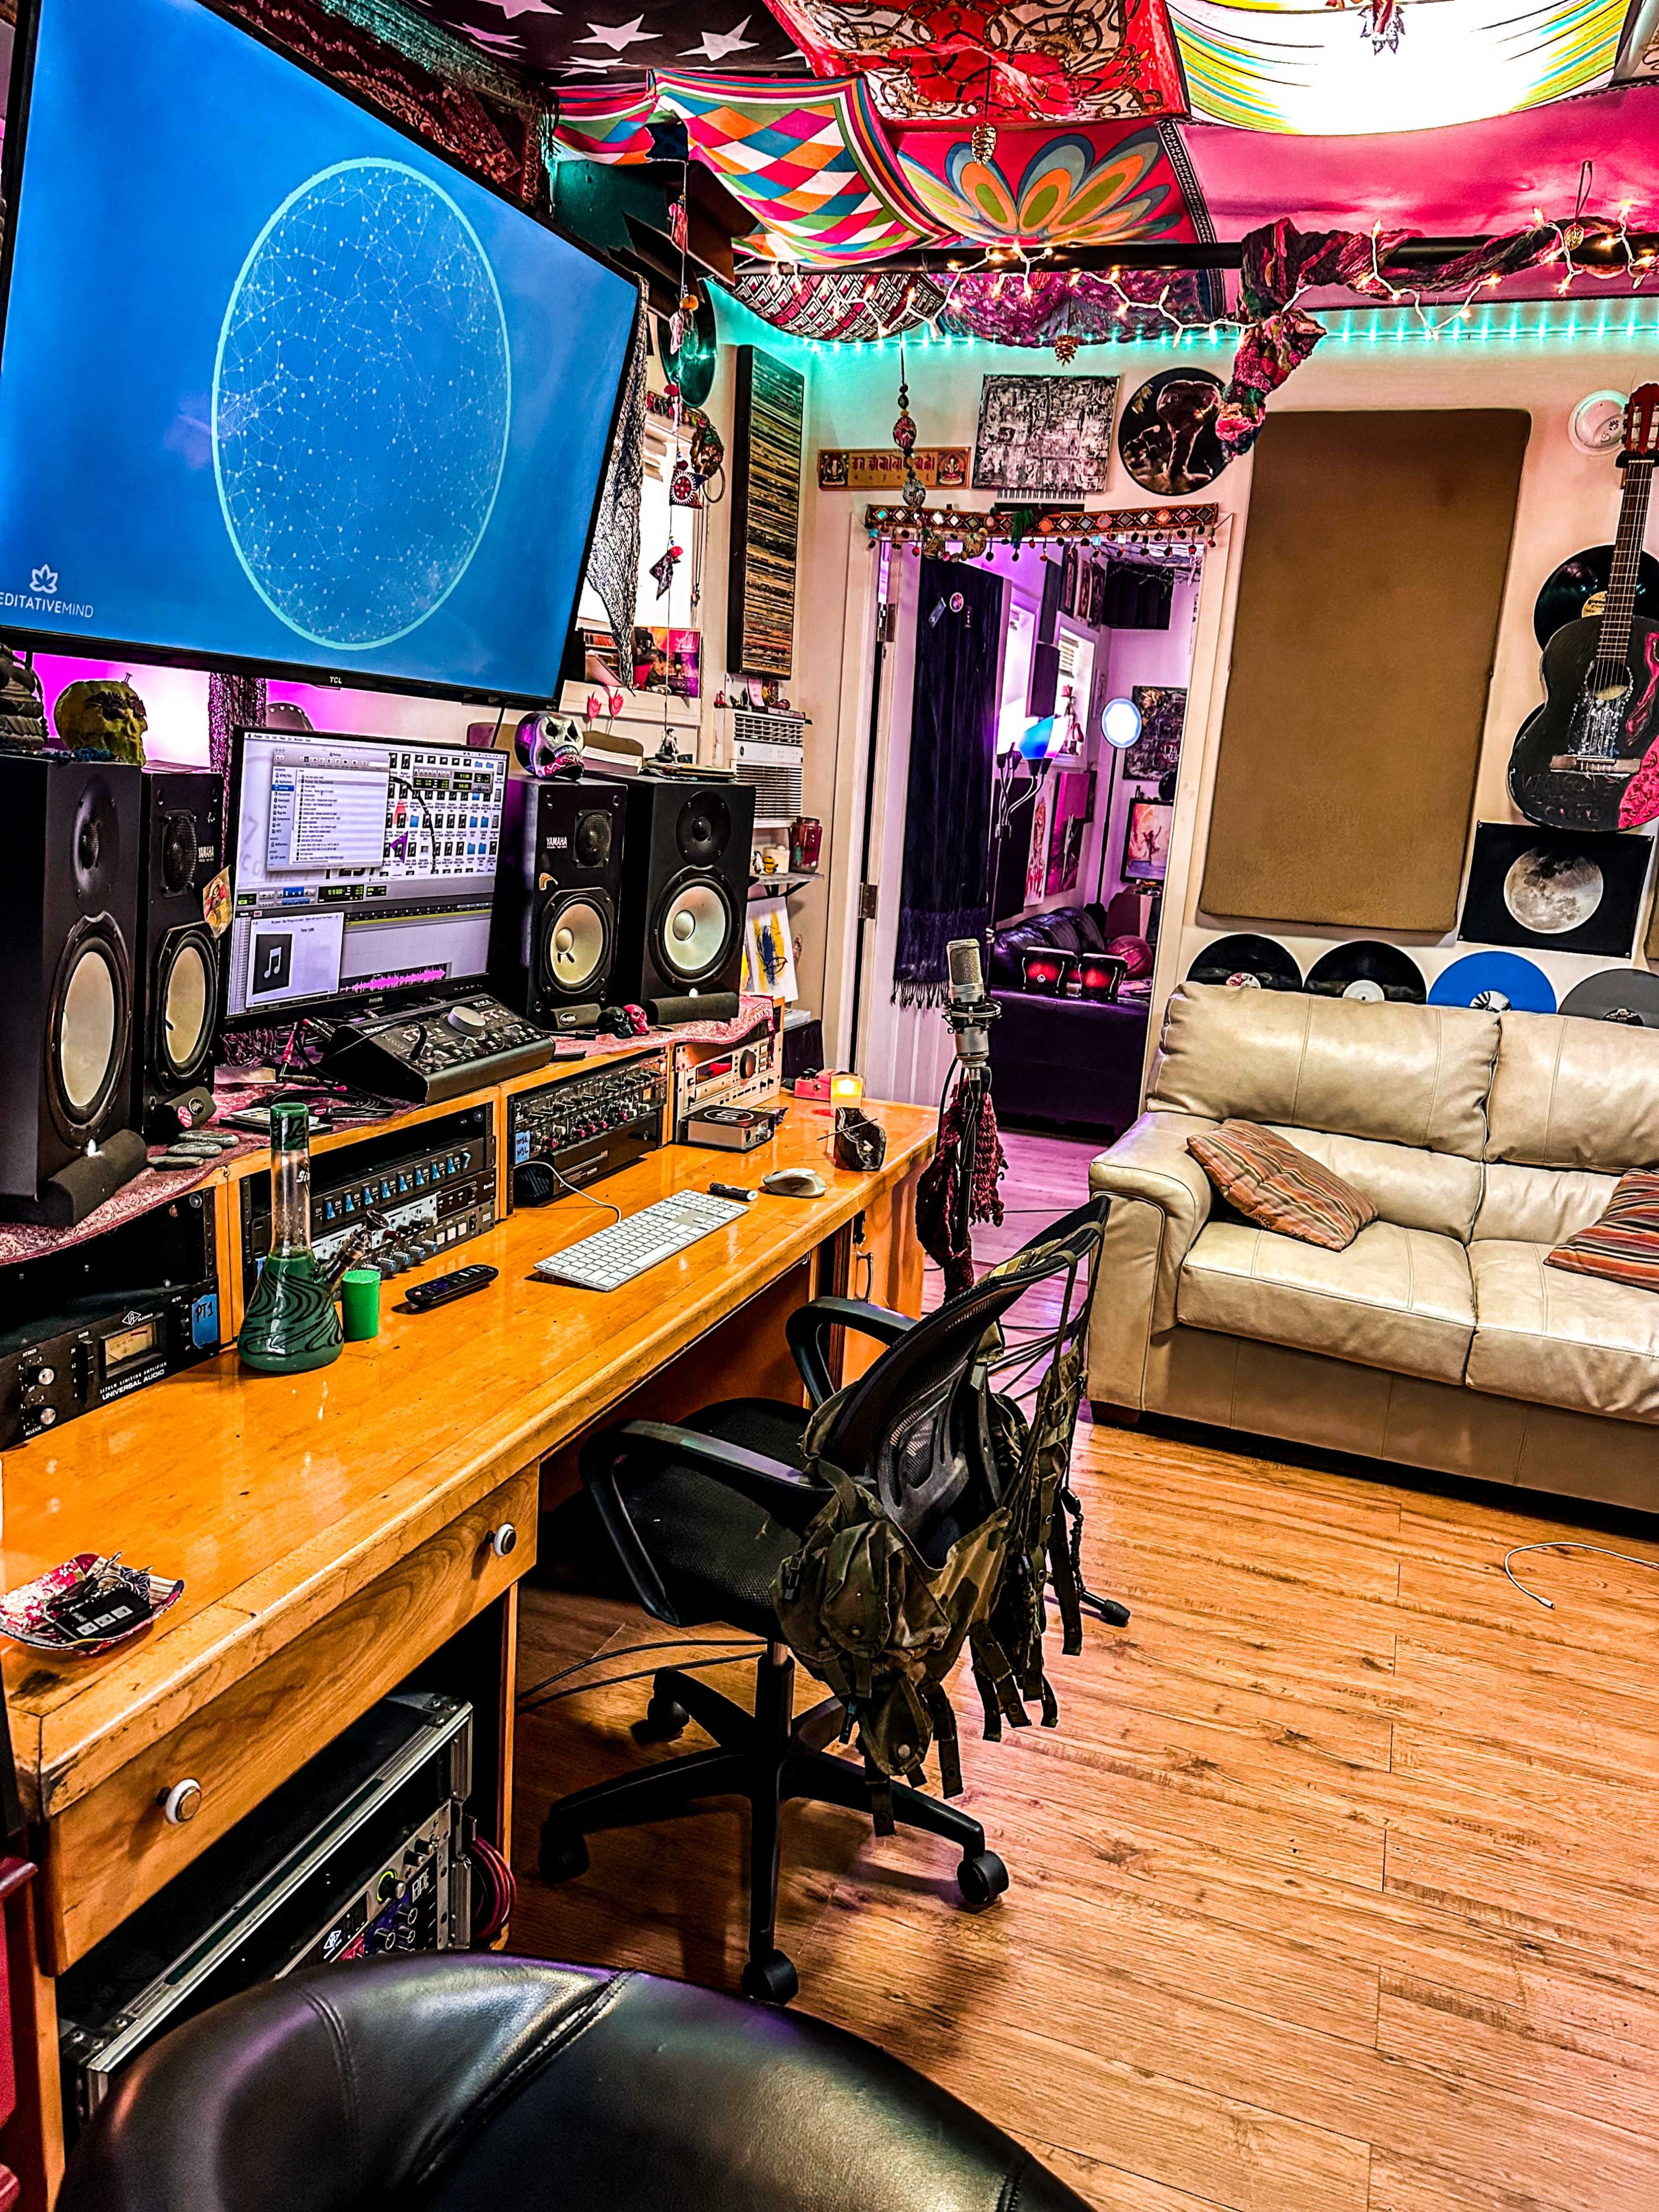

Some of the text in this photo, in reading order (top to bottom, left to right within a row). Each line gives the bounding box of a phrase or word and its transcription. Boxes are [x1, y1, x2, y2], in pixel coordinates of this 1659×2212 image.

[547, 836, 567, 845] YAMAHA
[195, 1302, 214, 1322] PT1
[22, 1348, 37, 1357] ATTACK
[120, 1373, 141, 1385] LIMITING
[143, 1362, 167, 1375] AMPLIFIER
[102, 1369, 165, 1400] UNIVERSAL AUDIO
[25, 1426, 42, 1436] RELEASE
